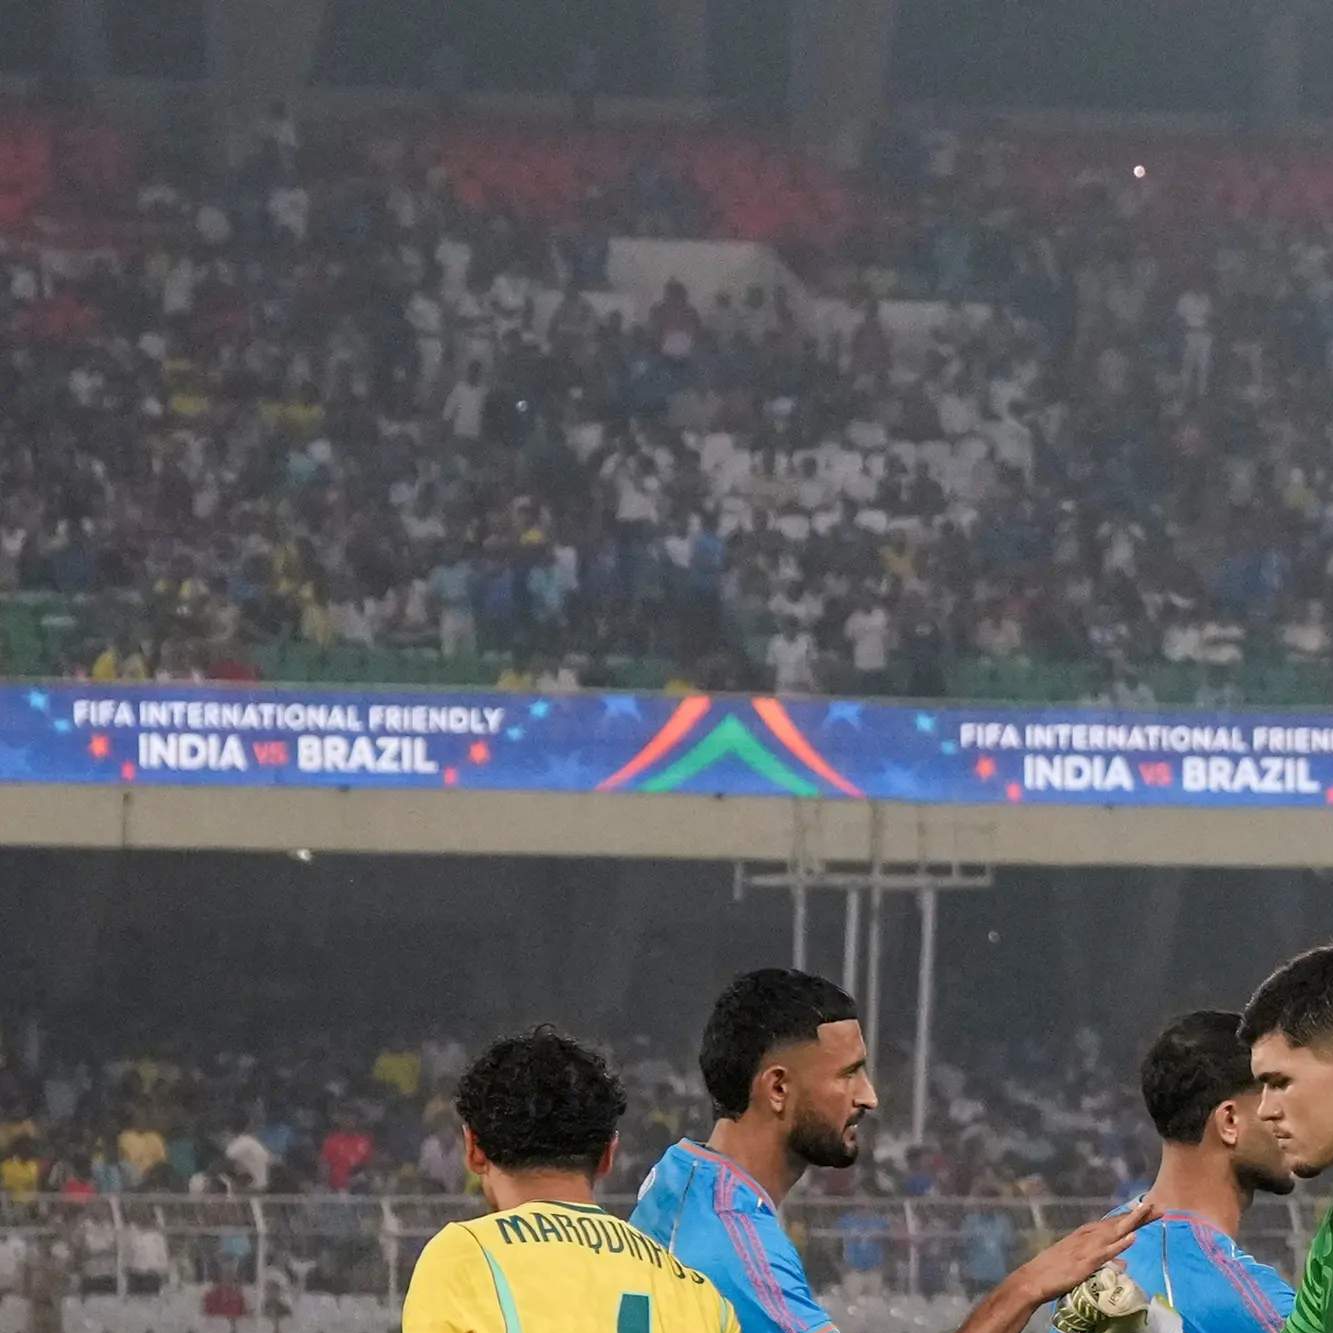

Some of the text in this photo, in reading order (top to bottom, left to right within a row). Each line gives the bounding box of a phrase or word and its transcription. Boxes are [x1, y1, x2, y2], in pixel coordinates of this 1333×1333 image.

[74, 701, 504, 735] FIFA INTERNATIONAL FRIENDLY
[139, 734, 248, 771] INDIA
[298, 736, 438, 774] BRAZIL
[961, 723, 1022, 750] FIFA
[1026, 724, 1247, 753] INTERNATIONAL
[1025, 756, 1135, 792] INDIA
[1183, 757, 1322, 794] BRAZIL
